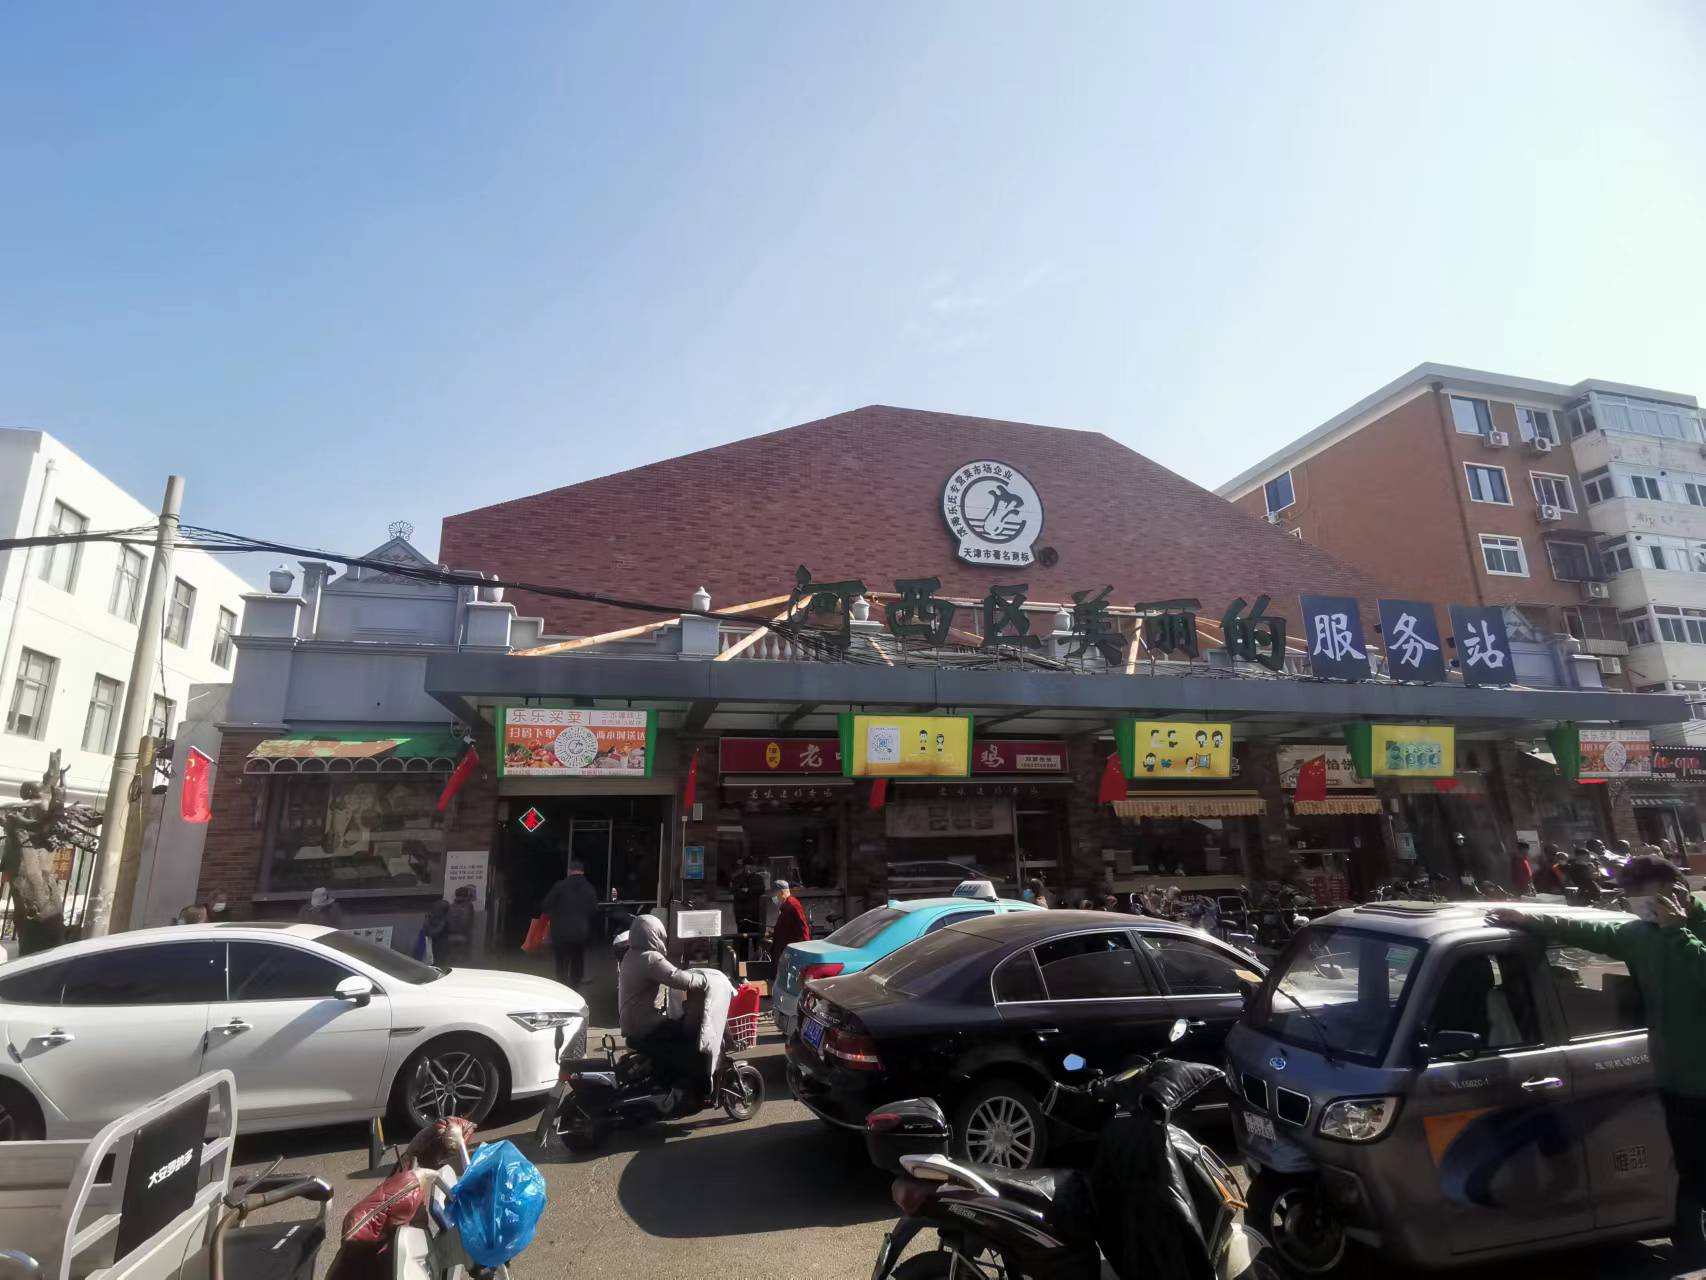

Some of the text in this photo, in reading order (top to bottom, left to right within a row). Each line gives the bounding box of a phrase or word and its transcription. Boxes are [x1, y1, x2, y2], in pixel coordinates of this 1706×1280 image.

[964, 547, 1030, 562] 天津市著名商标
[788, 565, 1286, 671] 河西区美丽的
[1313, 613, 1505, 669] 服务站
